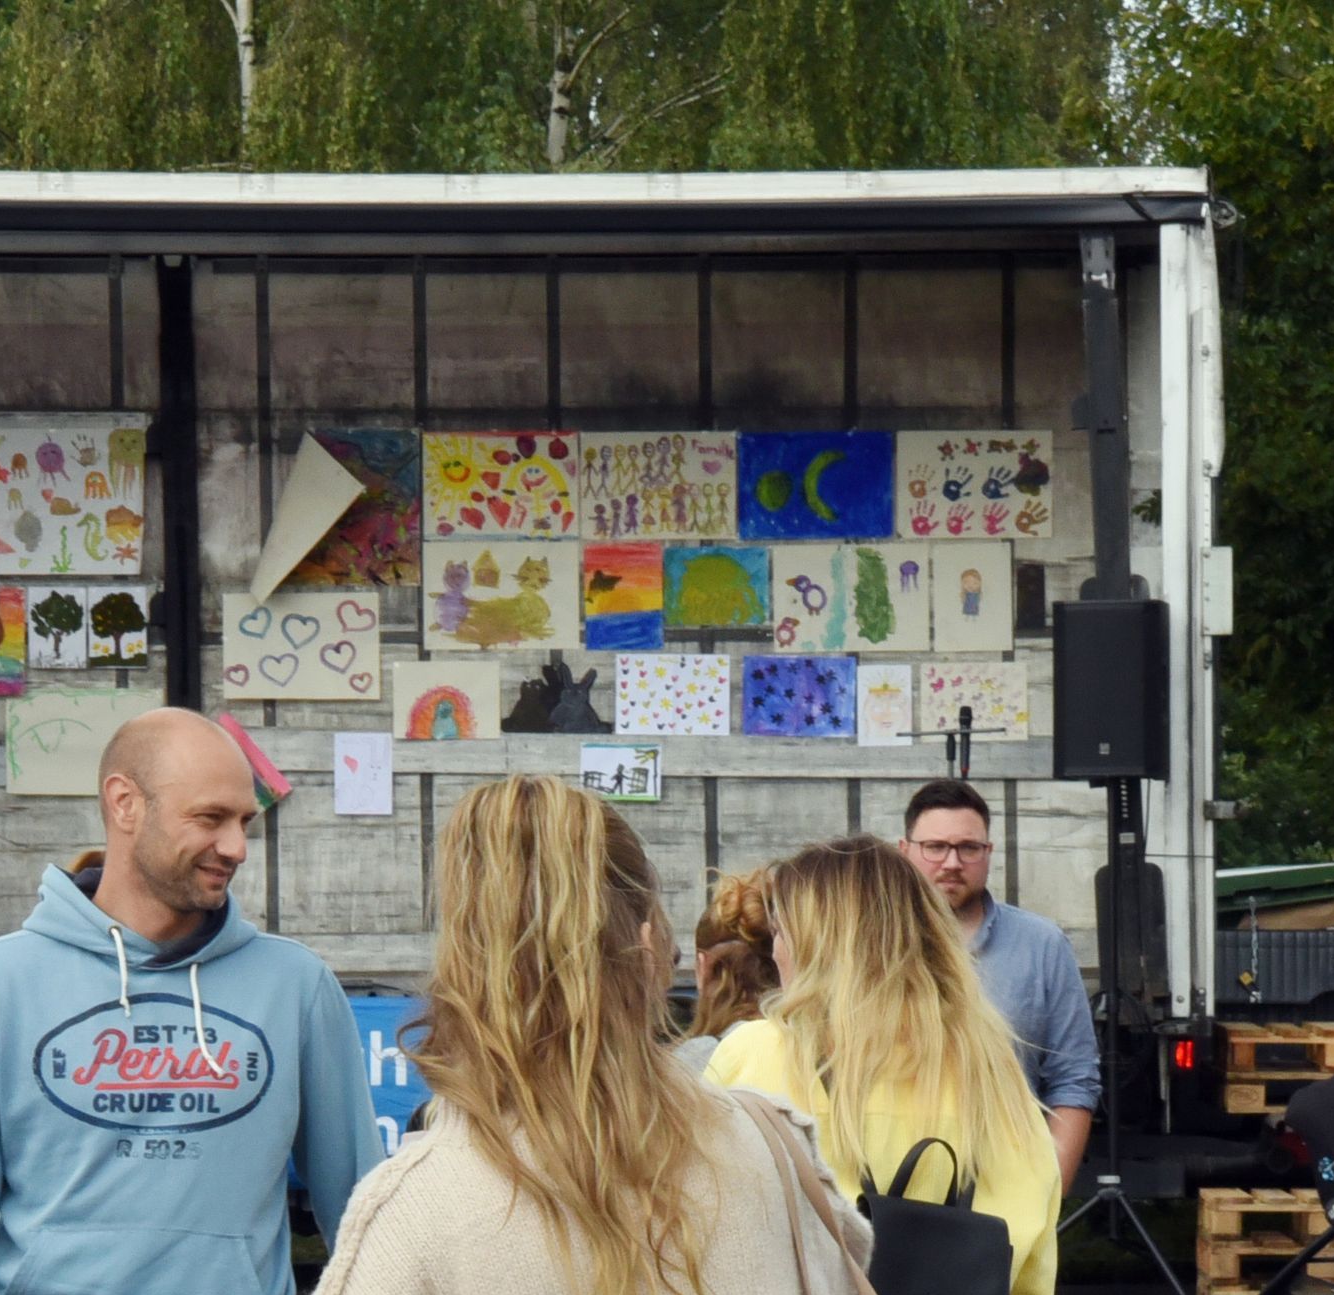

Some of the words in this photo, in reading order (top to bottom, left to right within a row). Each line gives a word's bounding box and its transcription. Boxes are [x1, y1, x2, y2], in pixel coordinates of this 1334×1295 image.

[133, 1025, 177, 1044] EST
[72, 1028, 233, 1086] Petrol
[92, 1093, 175, 1114] CRUDE
[180, 1093, 220, 1114] OIL
